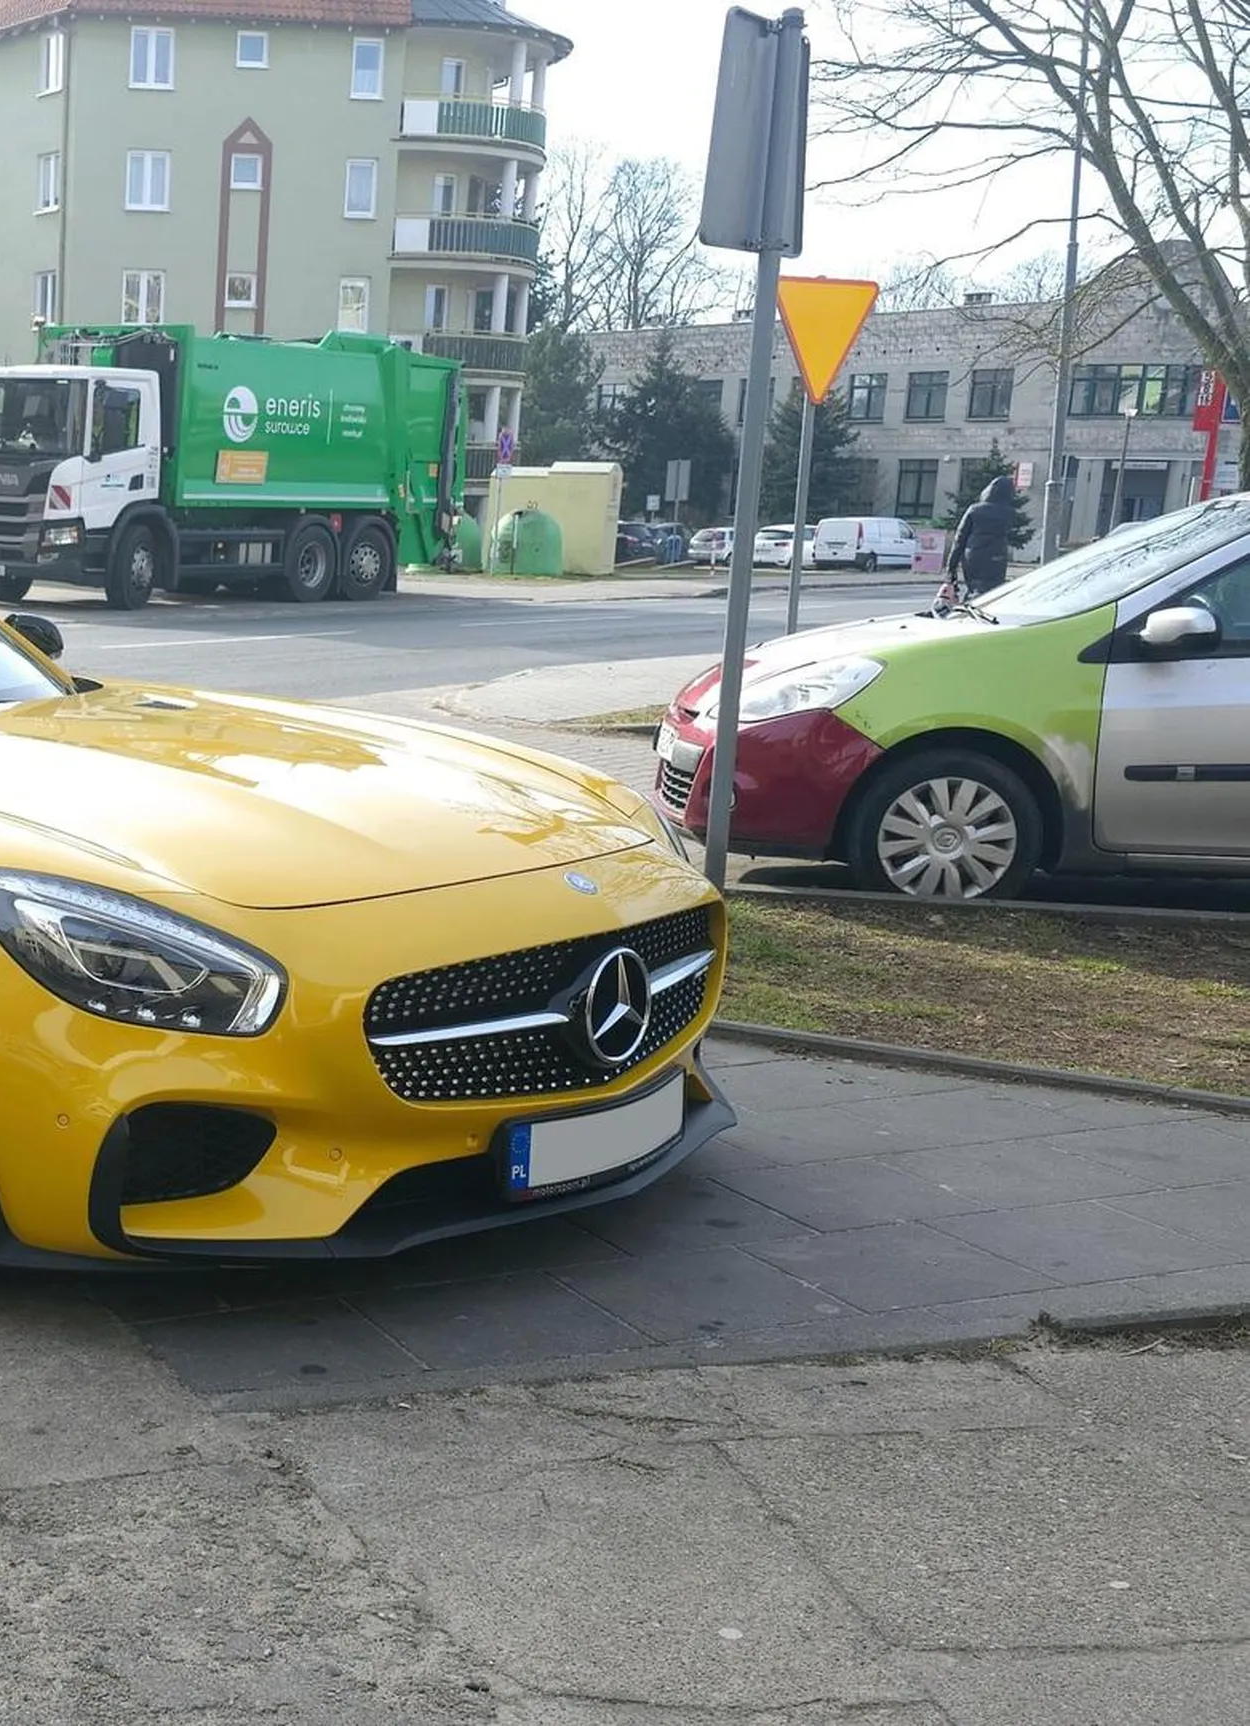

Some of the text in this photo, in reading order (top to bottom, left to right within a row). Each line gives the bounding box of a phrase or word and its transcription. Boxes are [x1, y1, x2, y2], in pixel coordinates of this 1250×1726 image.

[265, 393, 321, 418] eneris
[264, 421, 311, 435] surowce
[511, 1164, 527, 1180] PL
